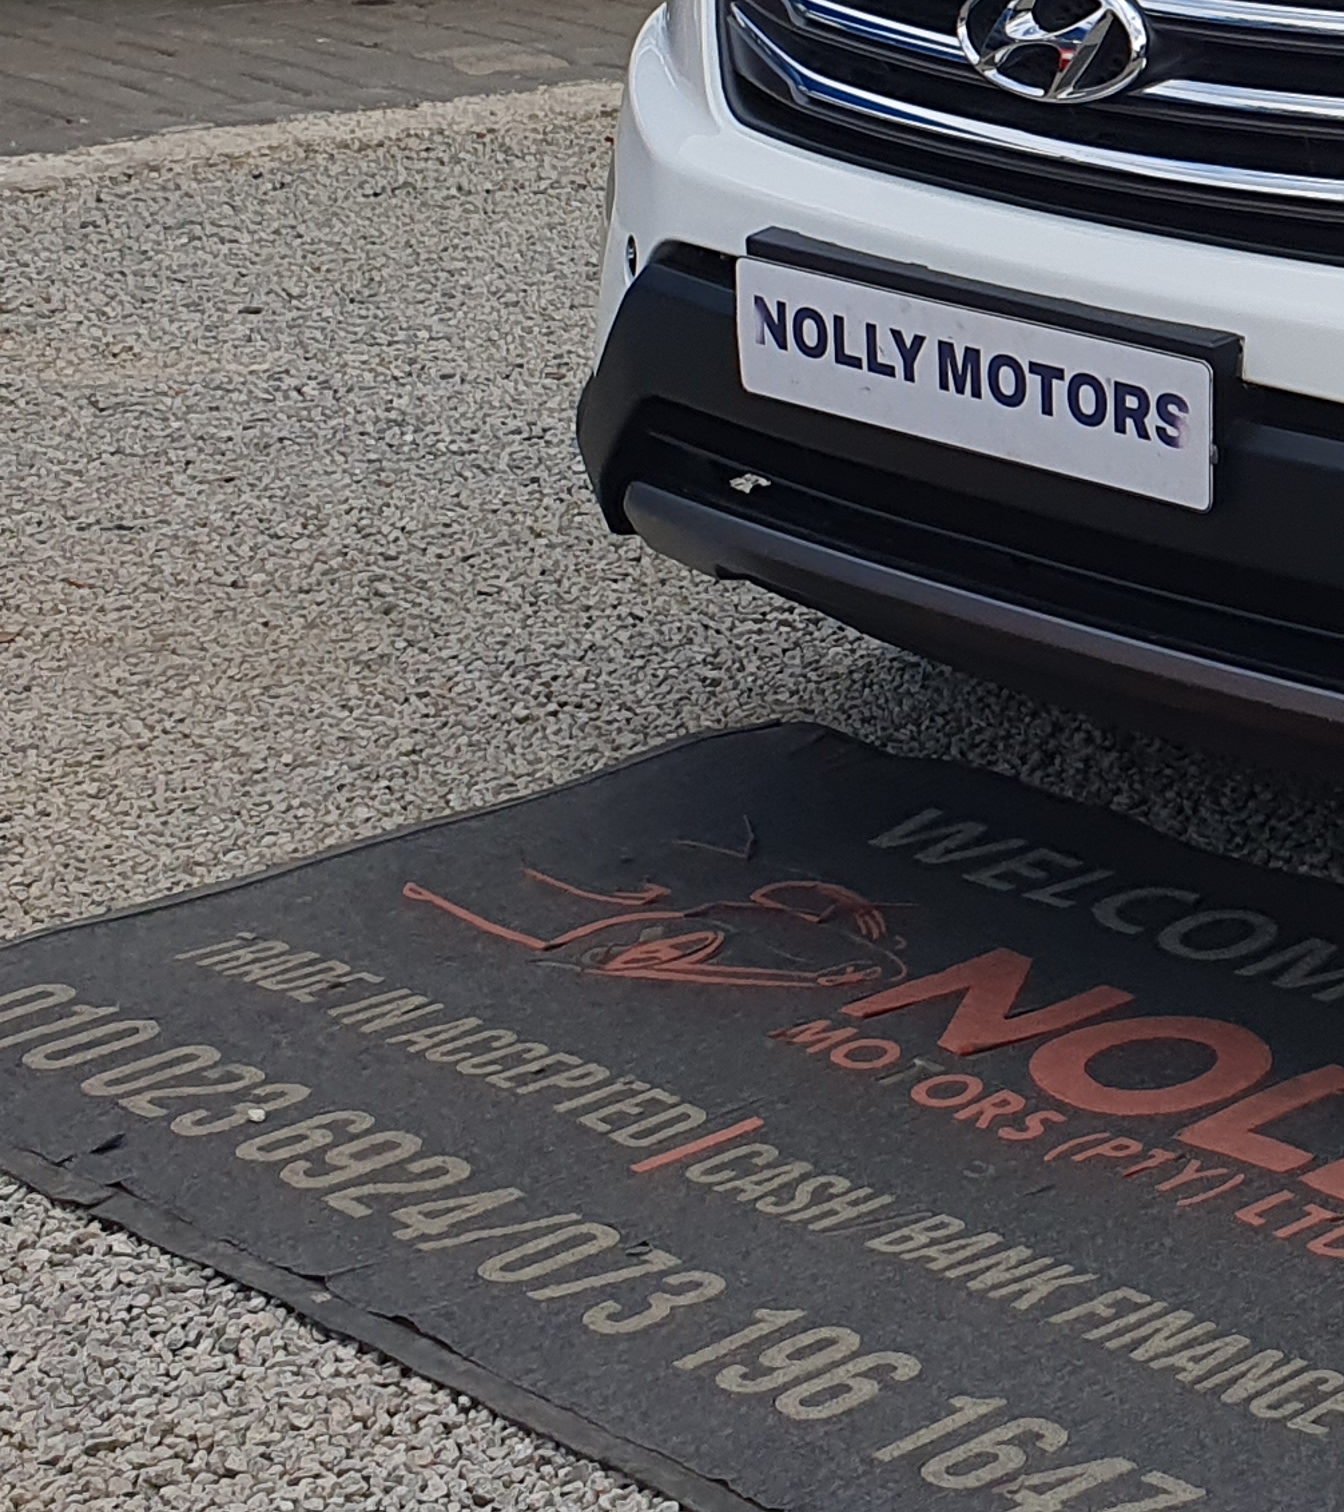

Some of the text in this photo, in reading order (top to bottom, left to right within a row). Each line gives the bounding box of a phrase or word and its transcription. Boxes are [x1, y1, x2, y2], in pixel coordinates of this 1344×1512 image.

[753, 294, 1191, 449] NOLLY MOTORS
[173, 932, 385, 1004] TRADE
[326, 987, 445, 1034] IN
[768, 1019, 1067, 1141] MOTORS
[1043, 1131, 1246, 1208] (PTY)
[0, 982, 1208, 1512] 010 023 6924/073 196 1647
